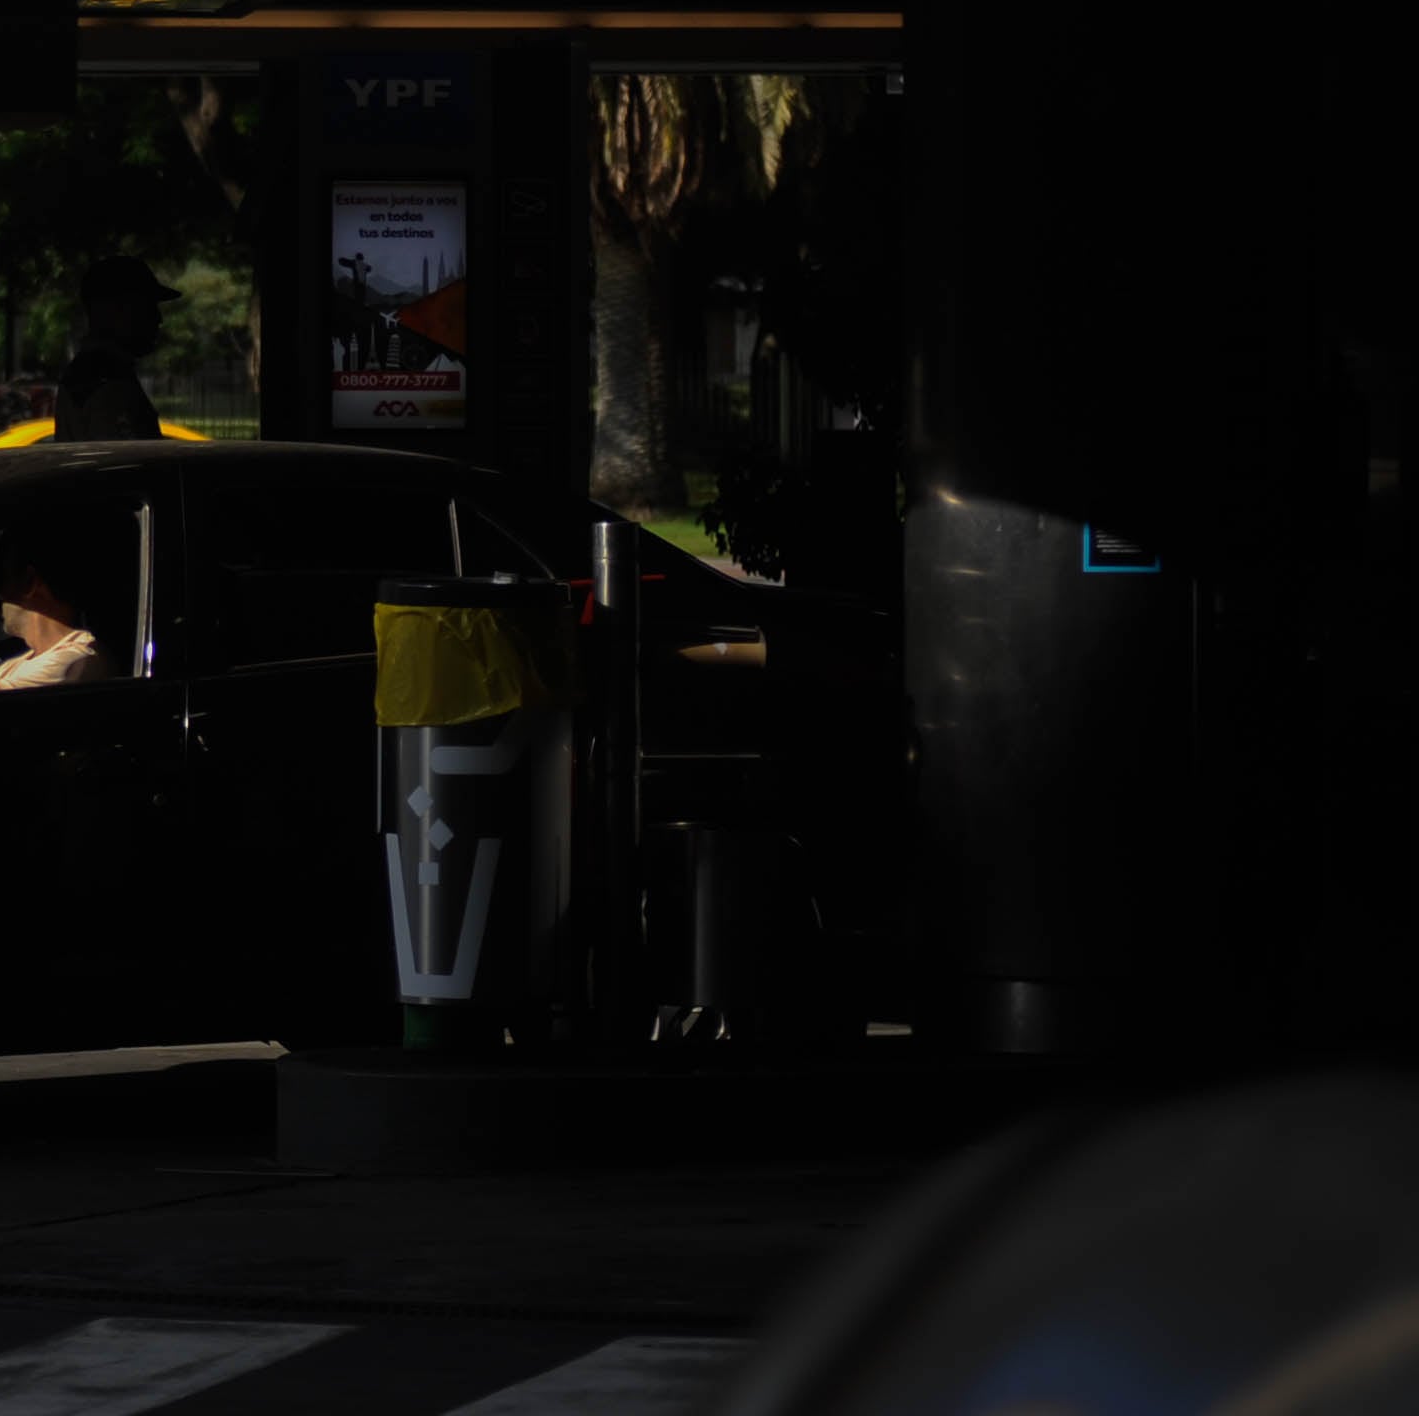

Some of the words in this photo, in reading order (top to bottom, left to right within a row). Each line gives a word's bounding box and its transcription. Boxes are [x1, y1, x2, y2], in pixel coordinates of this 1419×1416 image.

[344, 79, 452, 107] YPF
[336, 193, 389, 206] Estamos
[390, 192, 424, 208] junto
[435, 197, 458, 206] vos
[370, 213, 385, 222] en
[387, 211, 423, 222] todos
[358, 227, 380, 239] tus
[381, 226, 435, 239] destinos
[340, 375, 448, 386] 0800-777-3777
[374, 400, 419, 416] ACA
